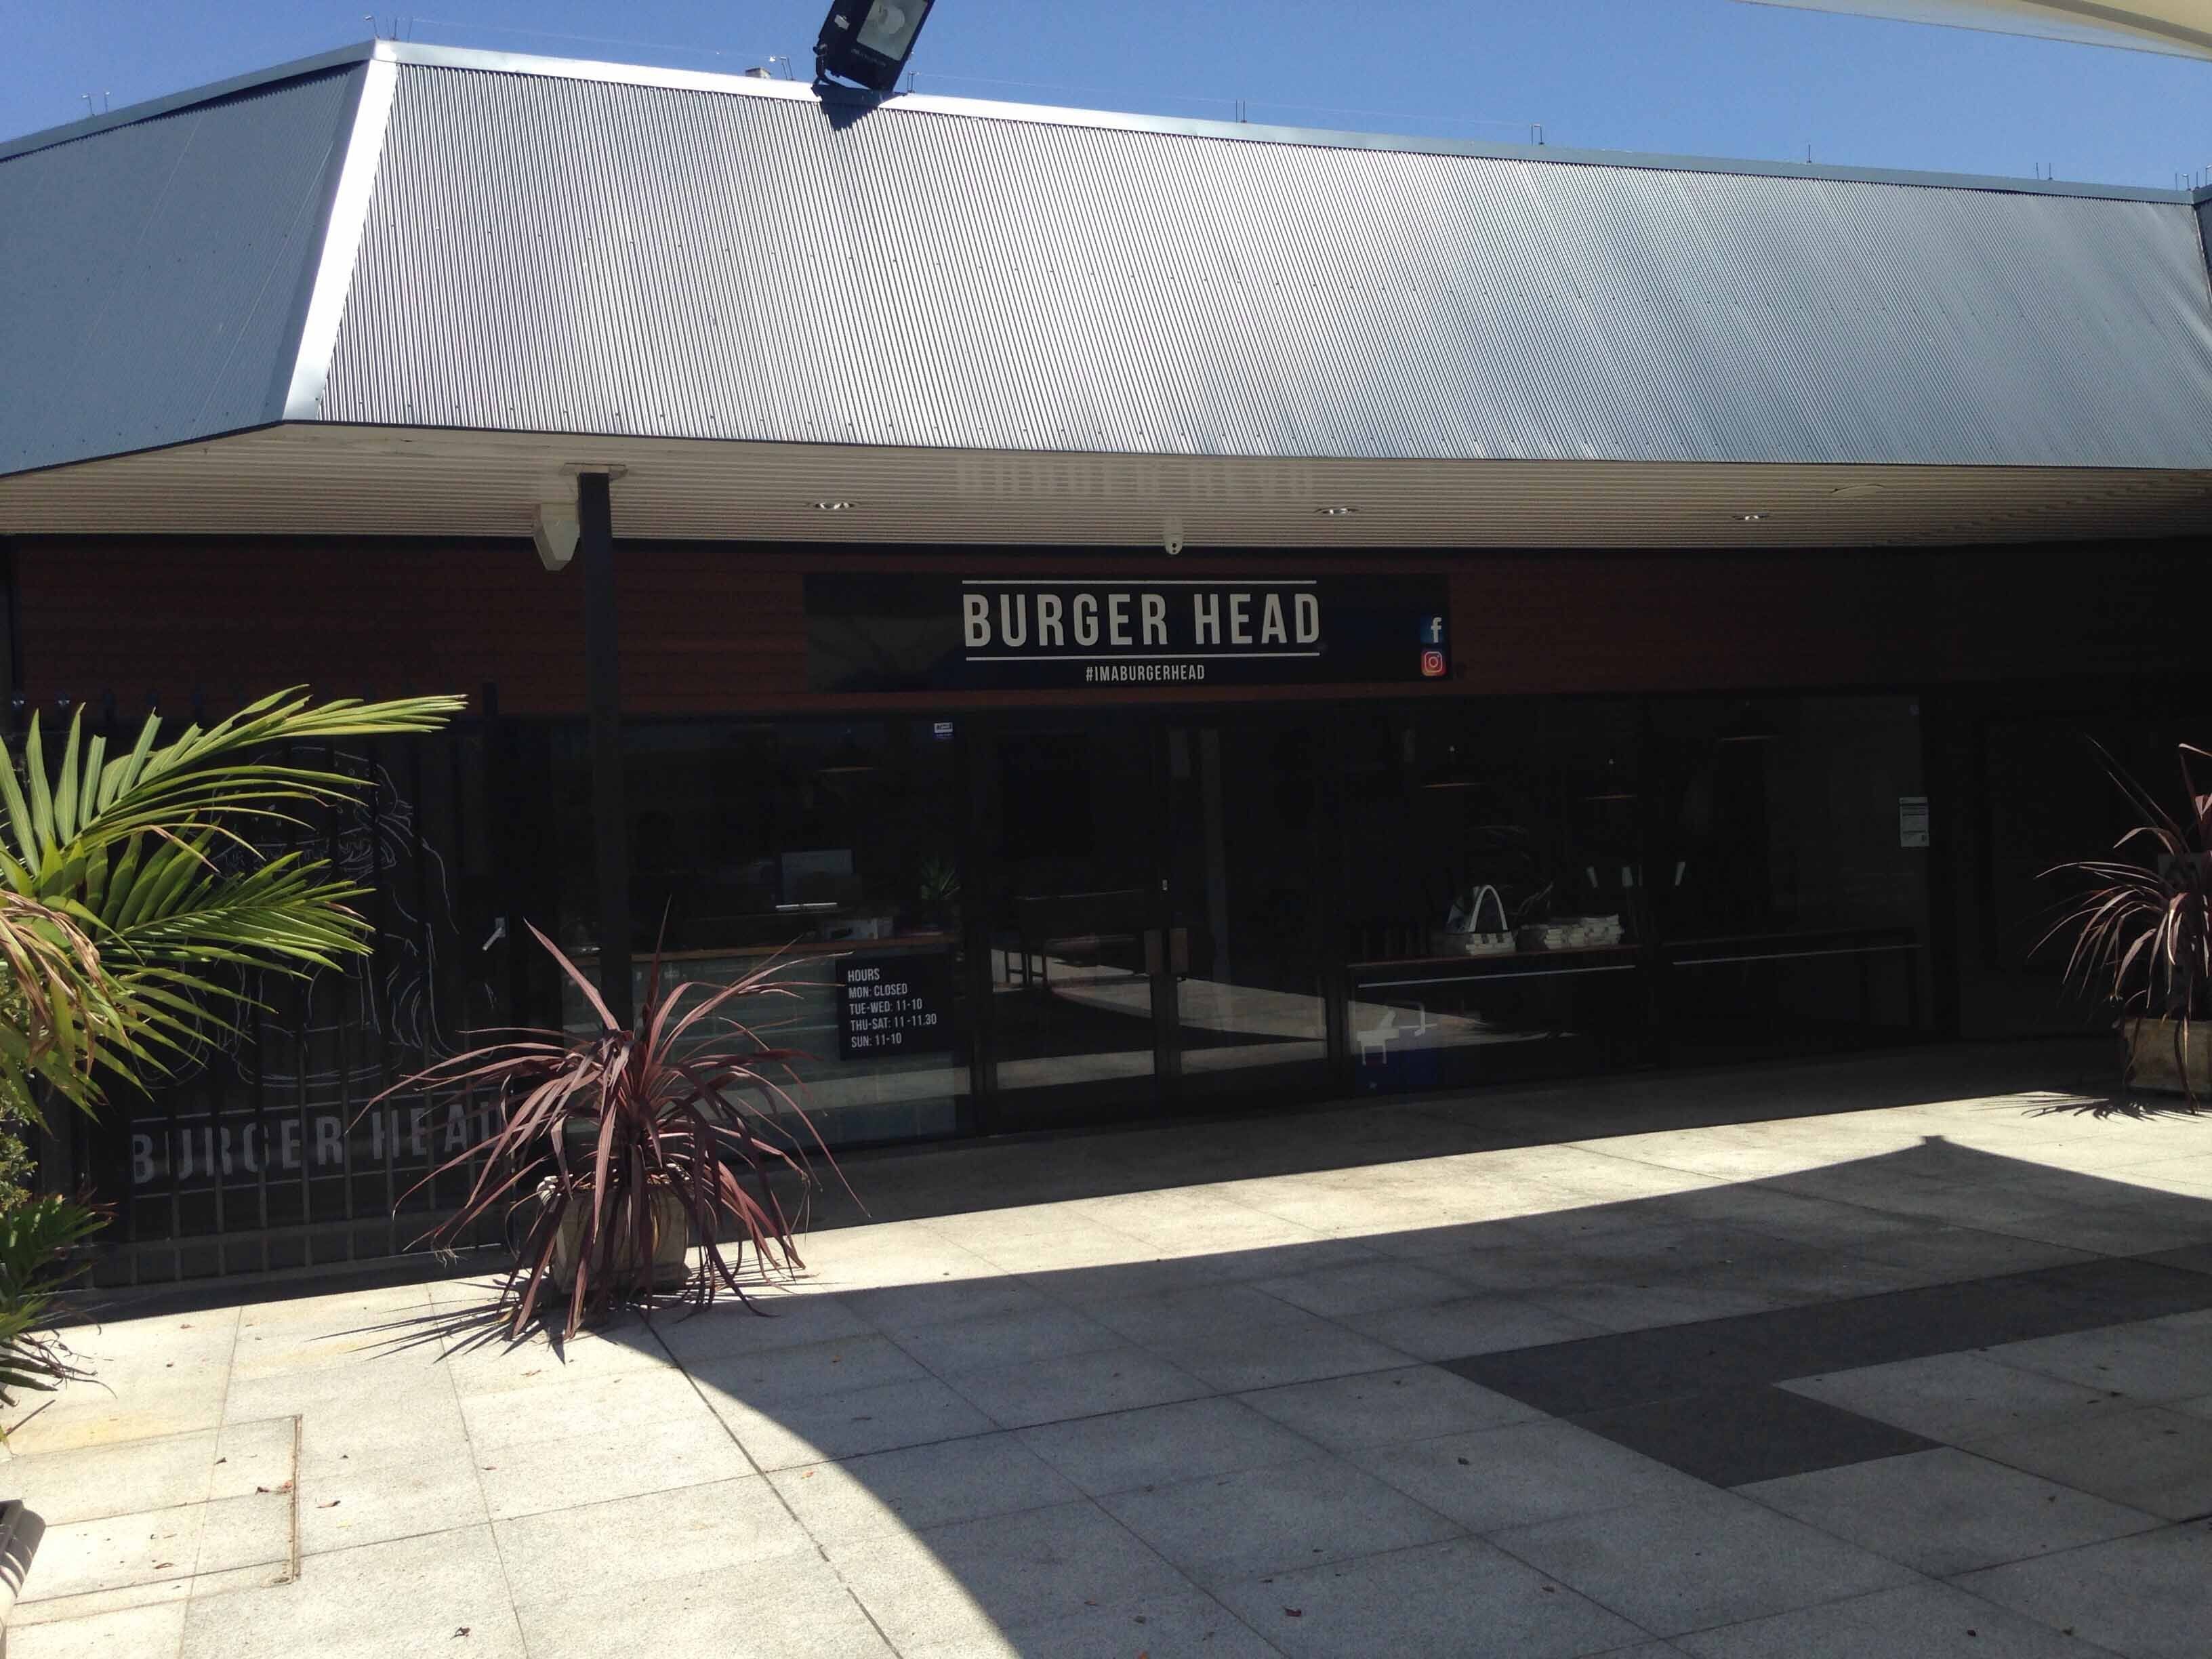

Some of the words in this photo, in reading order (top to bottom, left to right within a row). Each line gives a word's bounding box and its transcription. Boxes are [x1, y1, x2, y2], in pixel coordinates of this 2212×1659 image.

[963, 594, 1167, 647] BURGER
[1194, 594, 1319, 644] HEAD
[1086, 665, 1204, 681] #IMABURGERHEAD
[848, 968, 880, 982] HOURS
[848, 986, 872, 999] MON:
[874, 983, 908, 997] CLOSED
[850, 1001, 894, 1015] TUE-WED:
[897, 998, 922, 1012] 11-10
[851, 1017, 891, 1031] THU-SAT:
[851, 1036, 873, 1048] SUN:
[875, 1033, 902, 1046] 11-10
